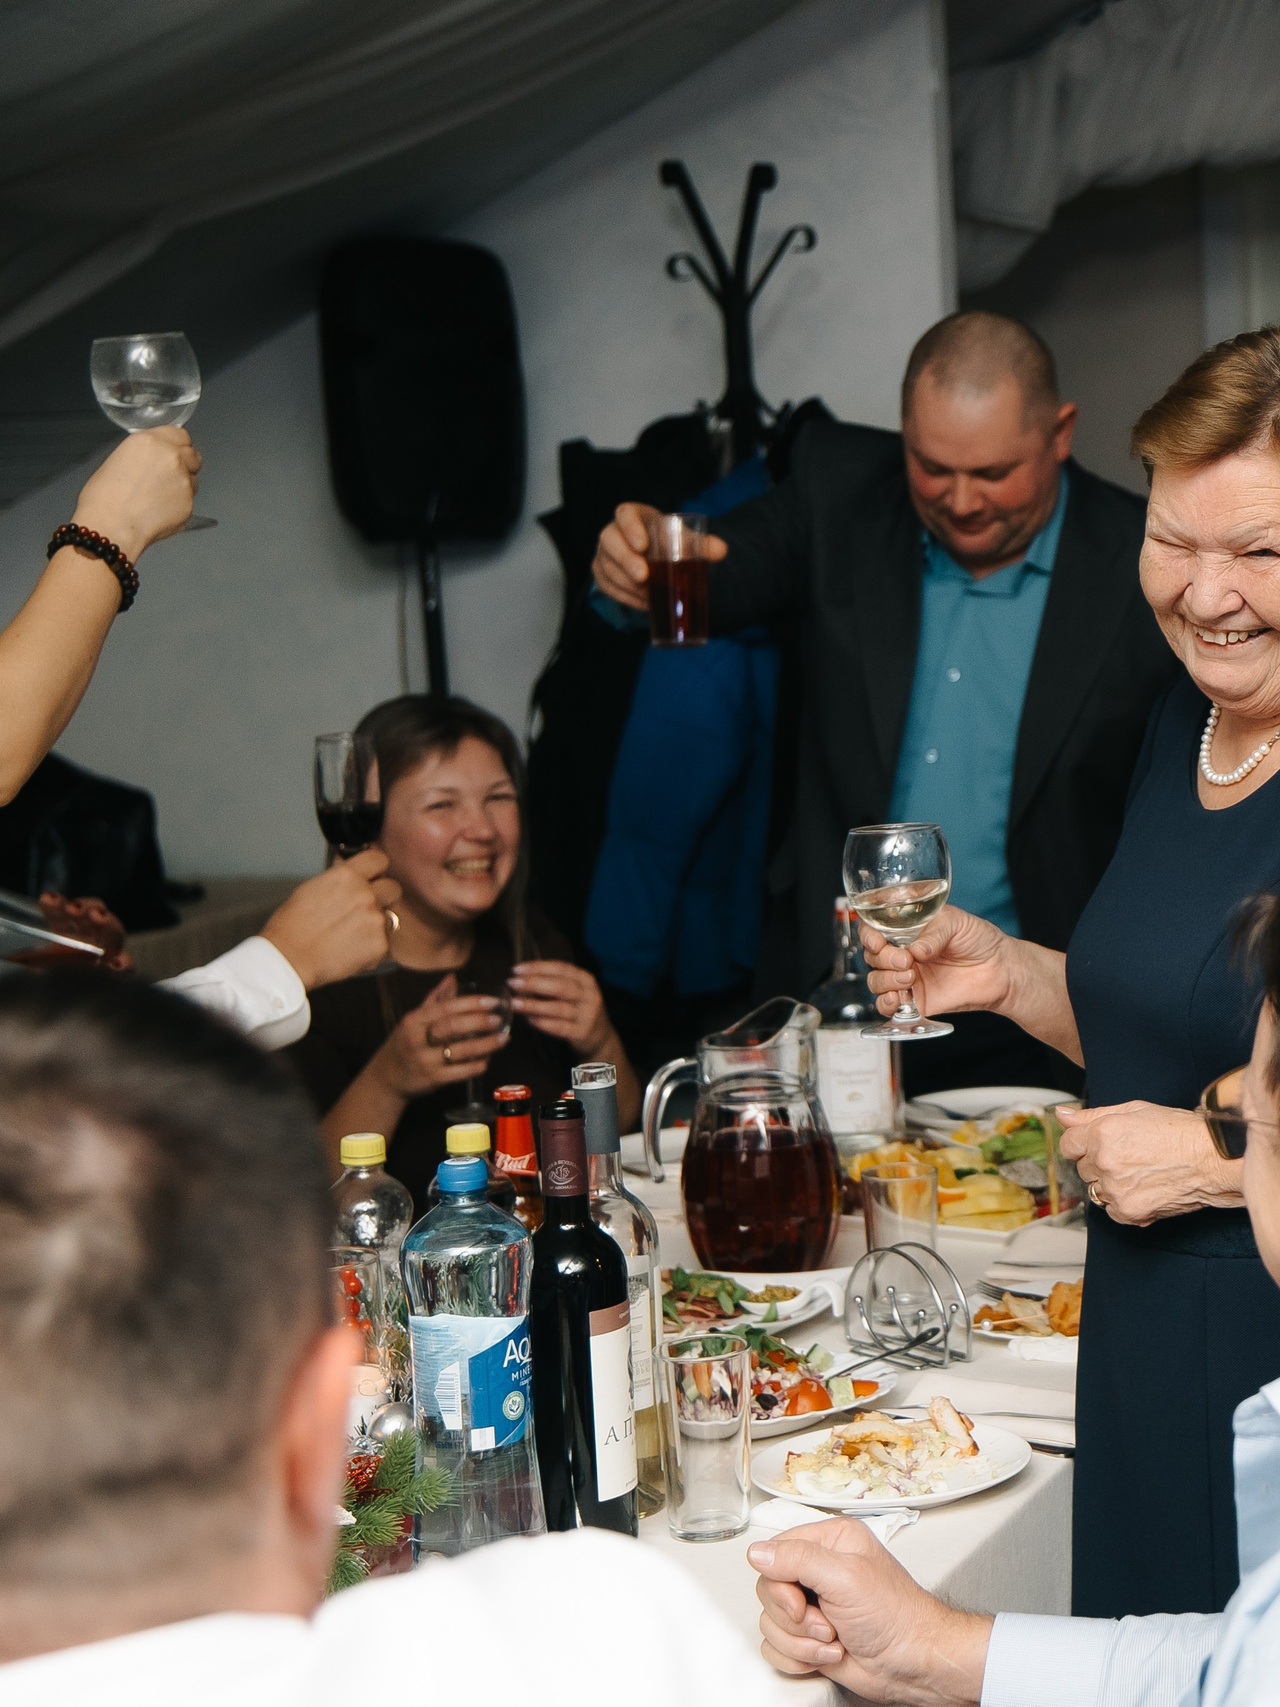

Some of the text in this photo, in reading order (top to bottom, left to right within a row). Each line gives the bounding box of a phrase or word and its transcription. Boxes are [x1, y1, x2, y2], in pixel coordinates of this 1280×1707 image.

[496, 1154, 531, 1172] Bud
[503, 1336, 532, 1368] AQ
[511, 1365, 532, 1382] MINE
[604, 1416, 633, 1446] АП
